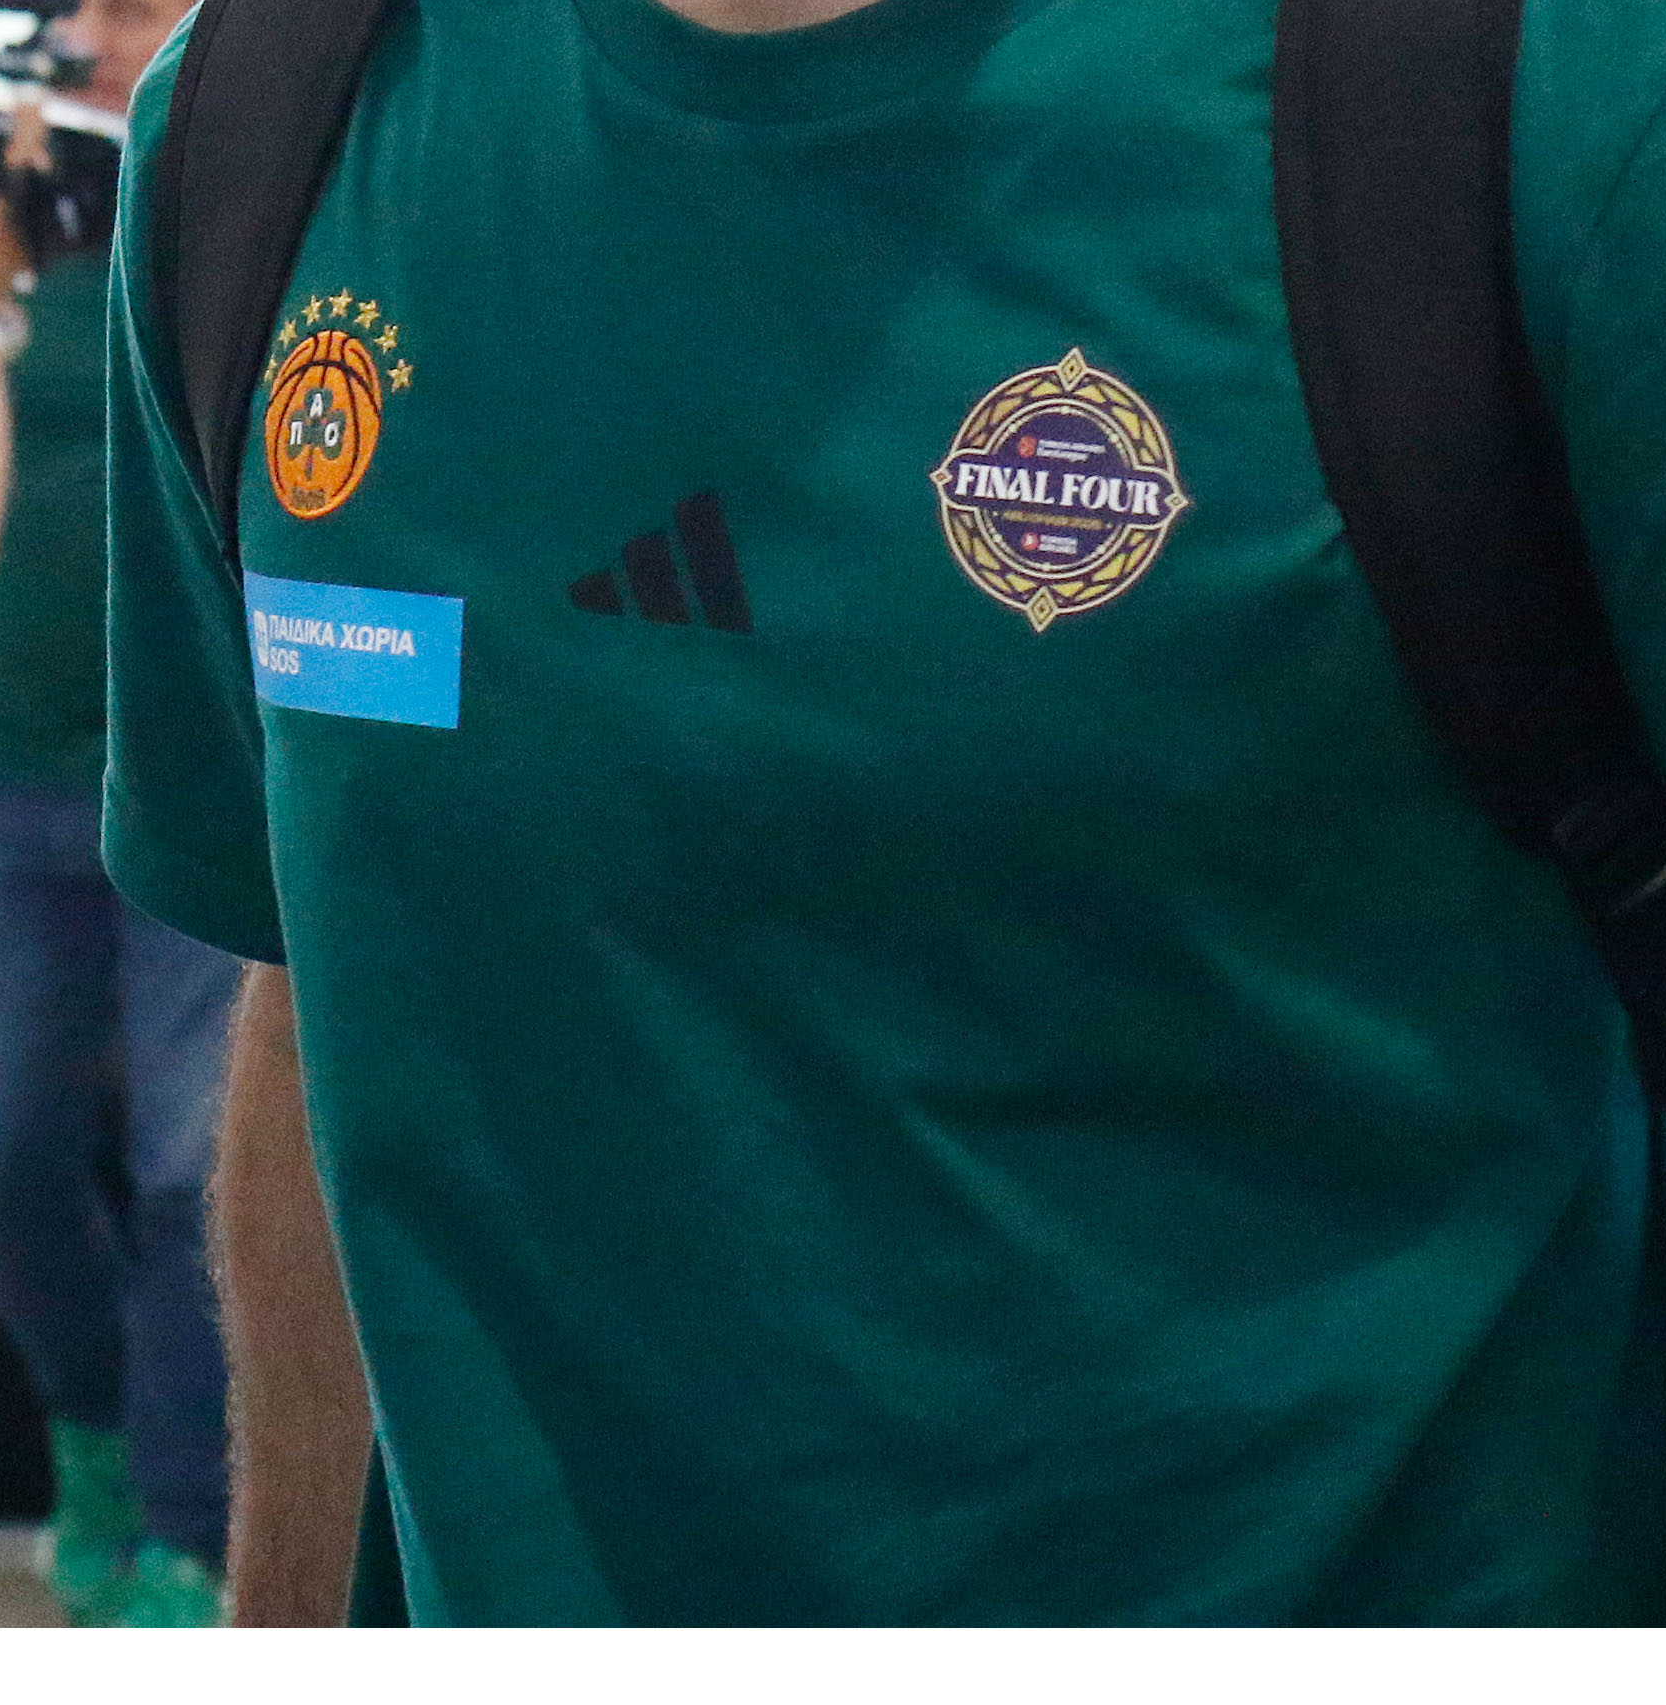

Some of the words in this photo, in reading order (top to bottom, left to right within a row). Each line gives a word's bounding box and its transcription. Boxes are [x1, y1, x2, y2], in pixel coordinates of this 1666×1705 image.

[954, 462, 1055, 506] FINAL
[1059, 472, 1161, 516] FOUR
[268, 614, 335, 647] ΠΑΙΔΙΚΑ
[339, 623, 416, 657] ΧΩΡΙΑ
[268, 645, 301, 675] SOS
